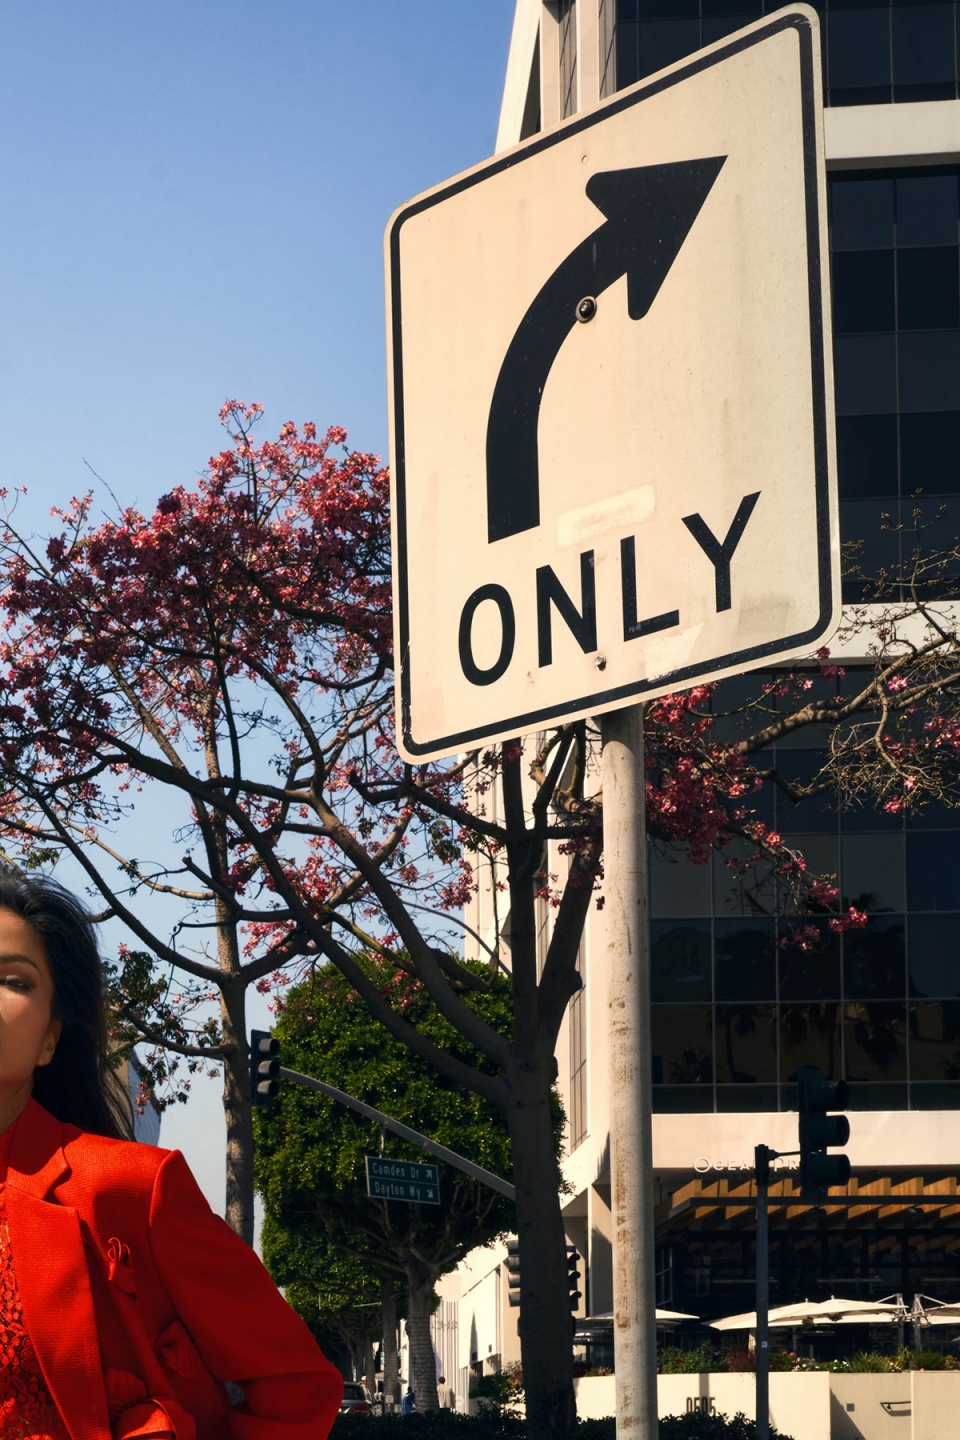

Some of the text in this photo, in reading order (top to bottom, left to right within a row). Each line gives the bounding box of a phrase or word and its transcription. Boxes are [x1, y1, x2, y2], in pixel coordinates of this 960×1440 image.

[458, 490, 762, 686] ONLY
[372, 1162, 420, 1179] Camden Dr
[693, 1157, 756, 1173] OCEA
[374, 1181, 421, 1200] Dayton Wy
